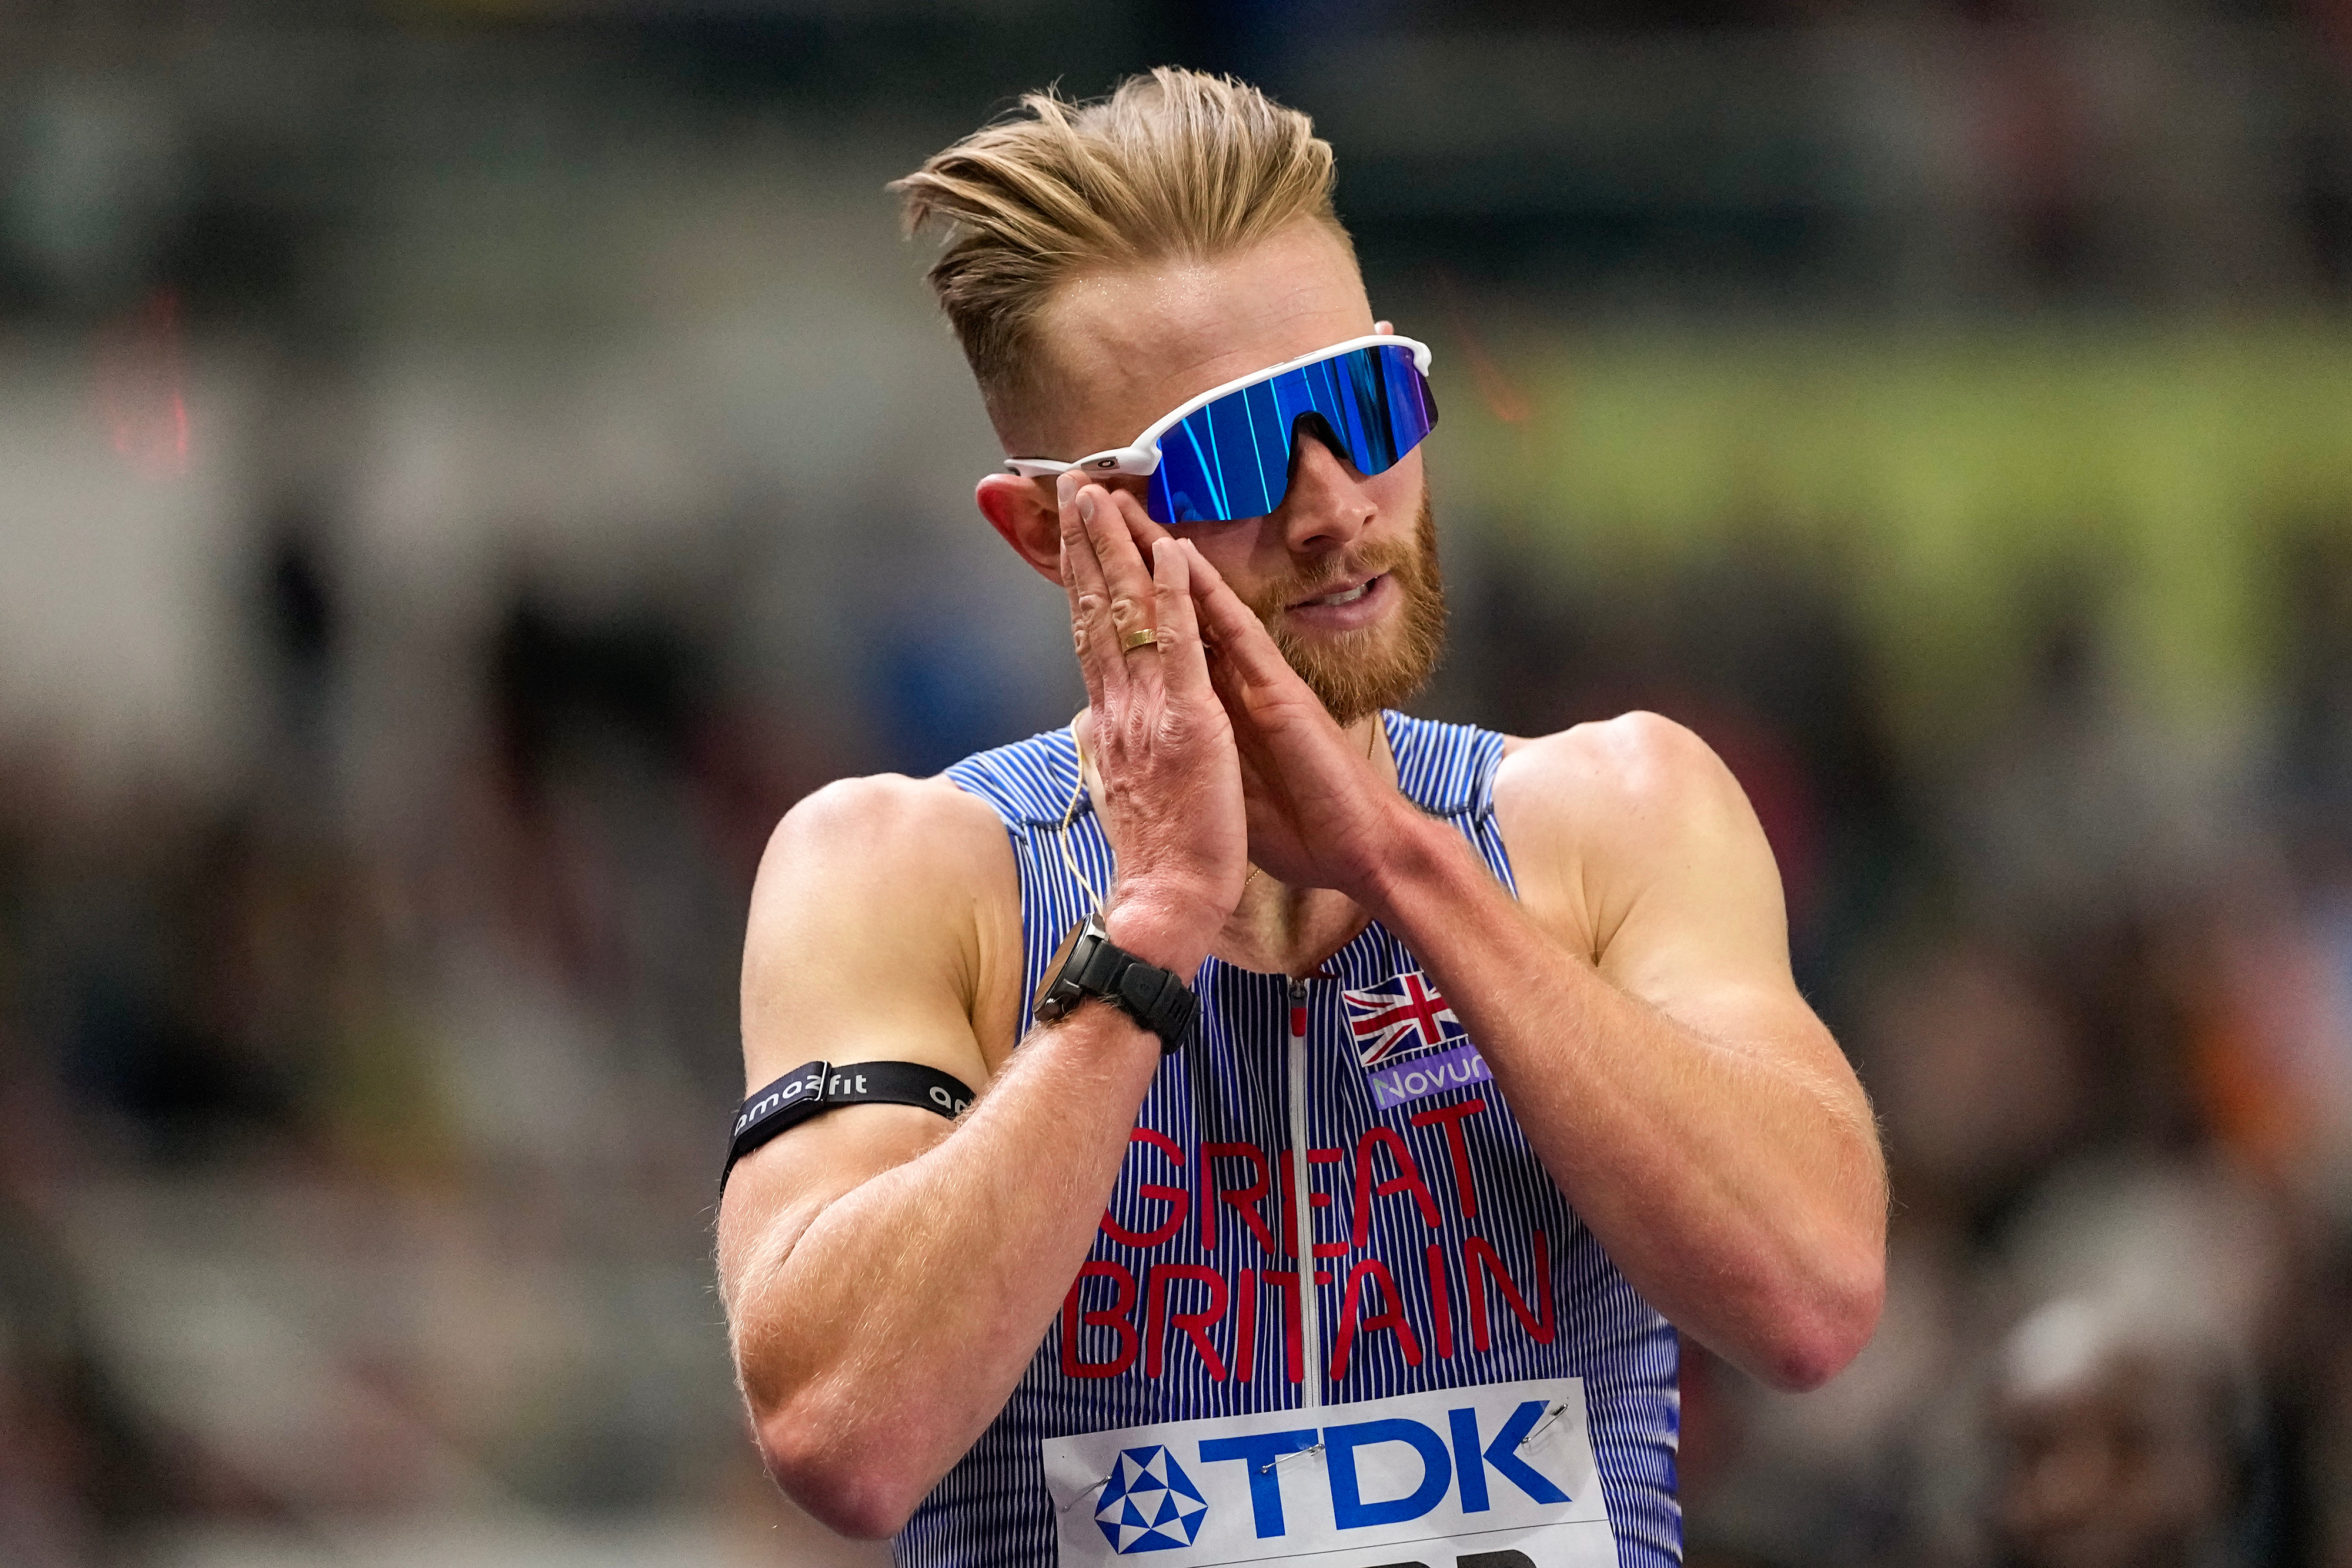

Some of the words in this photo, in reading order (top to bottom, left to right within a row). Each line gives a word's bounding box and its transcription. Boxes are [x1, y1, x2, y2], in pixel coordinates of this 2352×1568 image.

[1099, 1099, 1486, 1258] GREAT
[1063, 1229, 1555, 1384] BRITAIN
[1198, 1400, 1572, 1539] TDK
